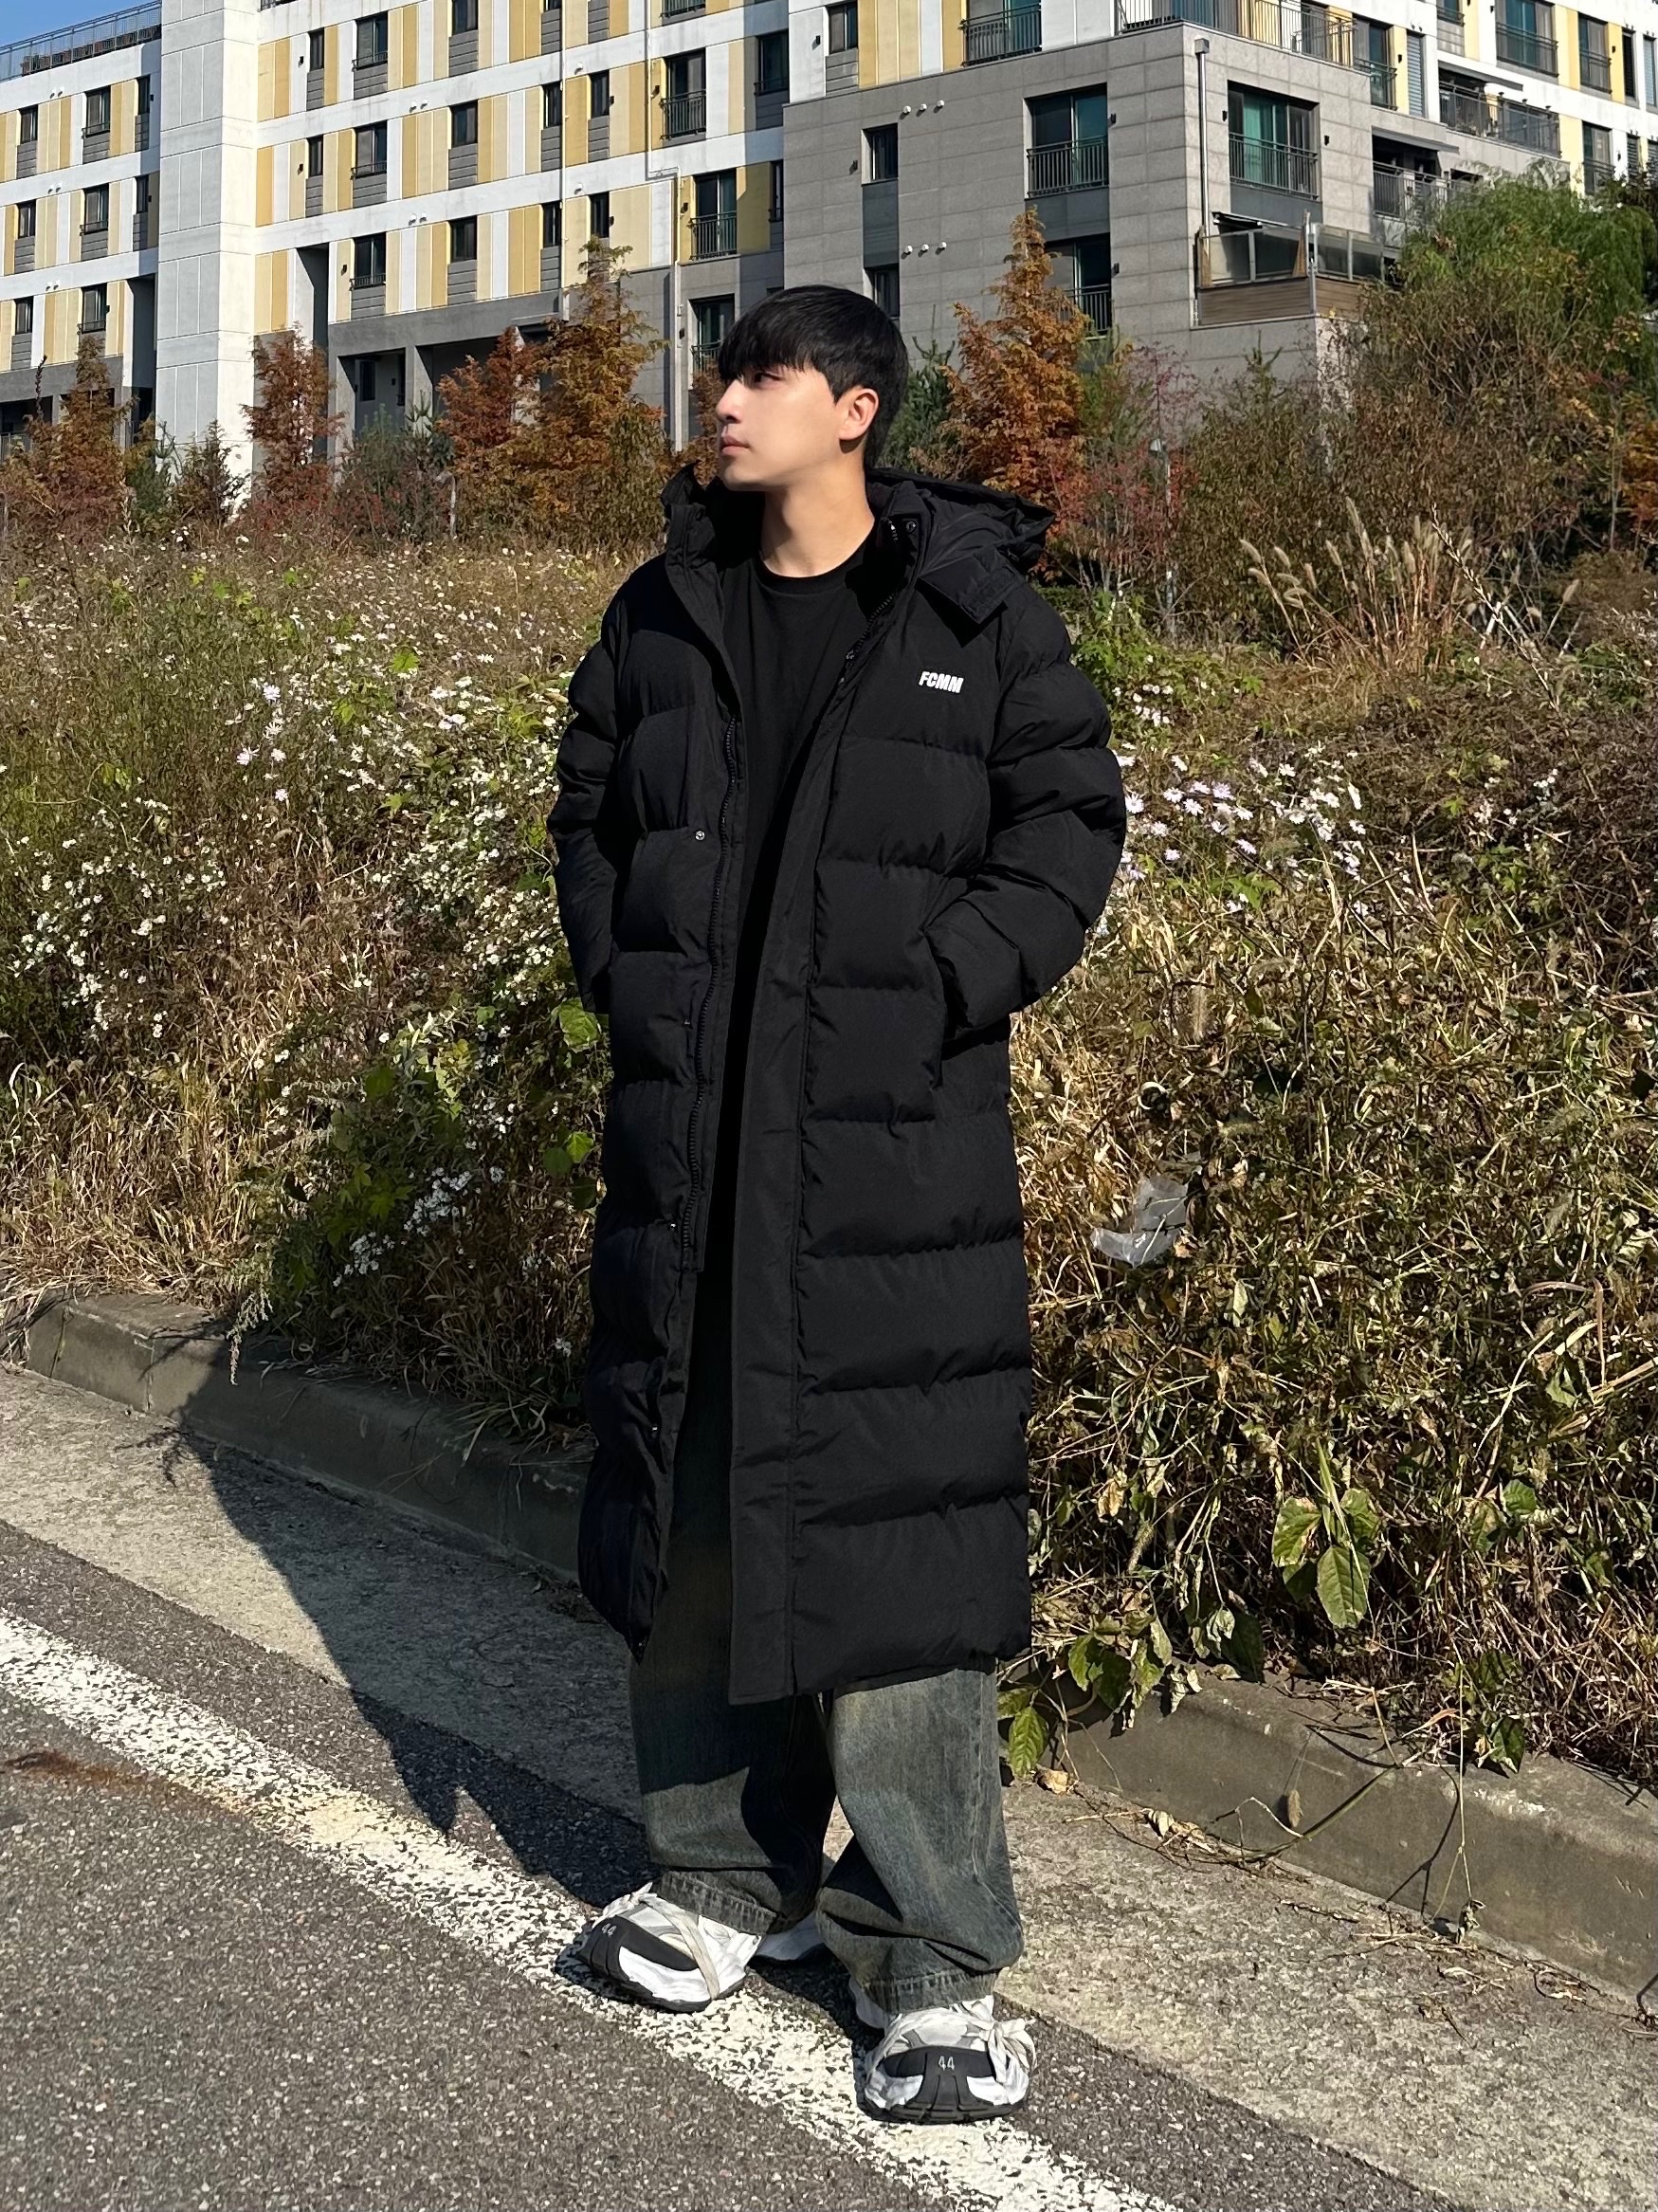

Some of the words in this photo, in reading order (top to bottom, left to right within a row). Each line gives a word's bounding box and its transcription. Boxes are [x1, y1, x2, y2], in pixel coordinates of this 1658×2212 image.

[919, 671, 964, 694] FCMM
[601, 1923, 617, 1937] 44
[938, 2056, 955, 2071] 44
